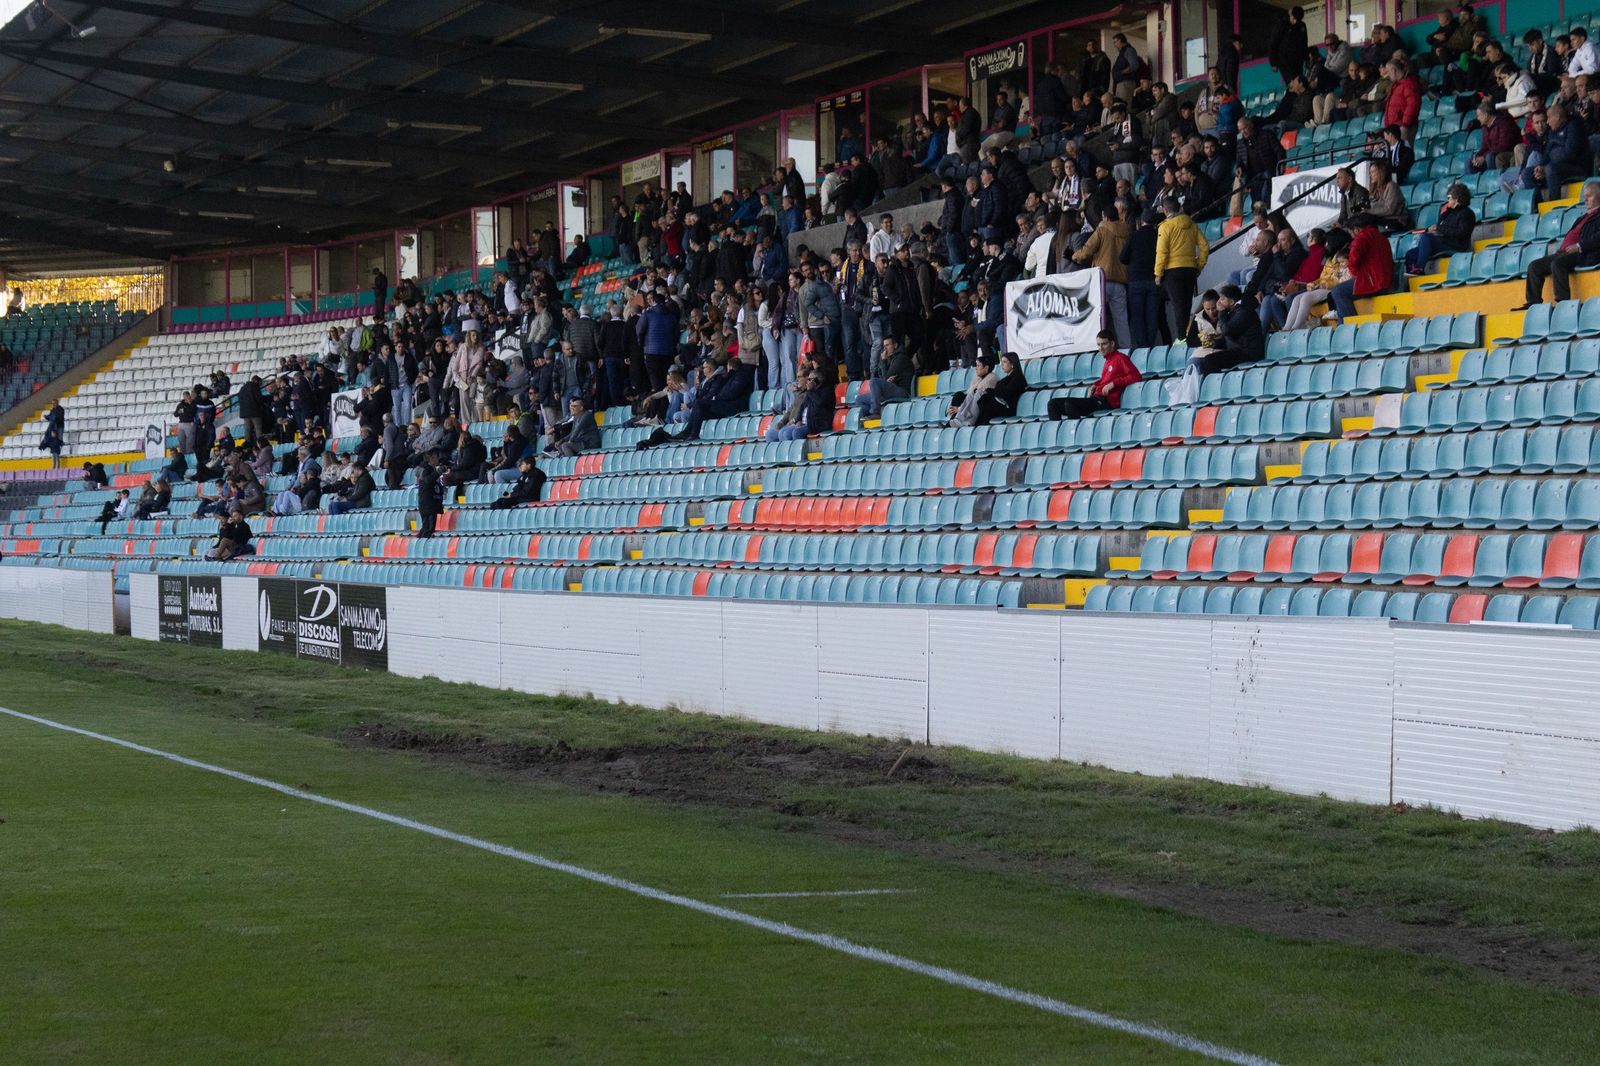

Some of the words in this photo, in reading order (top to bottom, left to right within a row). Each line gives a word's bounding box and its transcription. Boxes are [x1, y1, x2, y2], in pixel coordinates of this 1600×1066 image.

[1026, 290, 1080, 318] ALJOMAR
[190, 586, 218, 611] Autolack
[189, 614, 213, 636] PINTURAS,
[298, 621, 339, 642] DISCOSA
[352, 630, 379, 651] TELECOM
